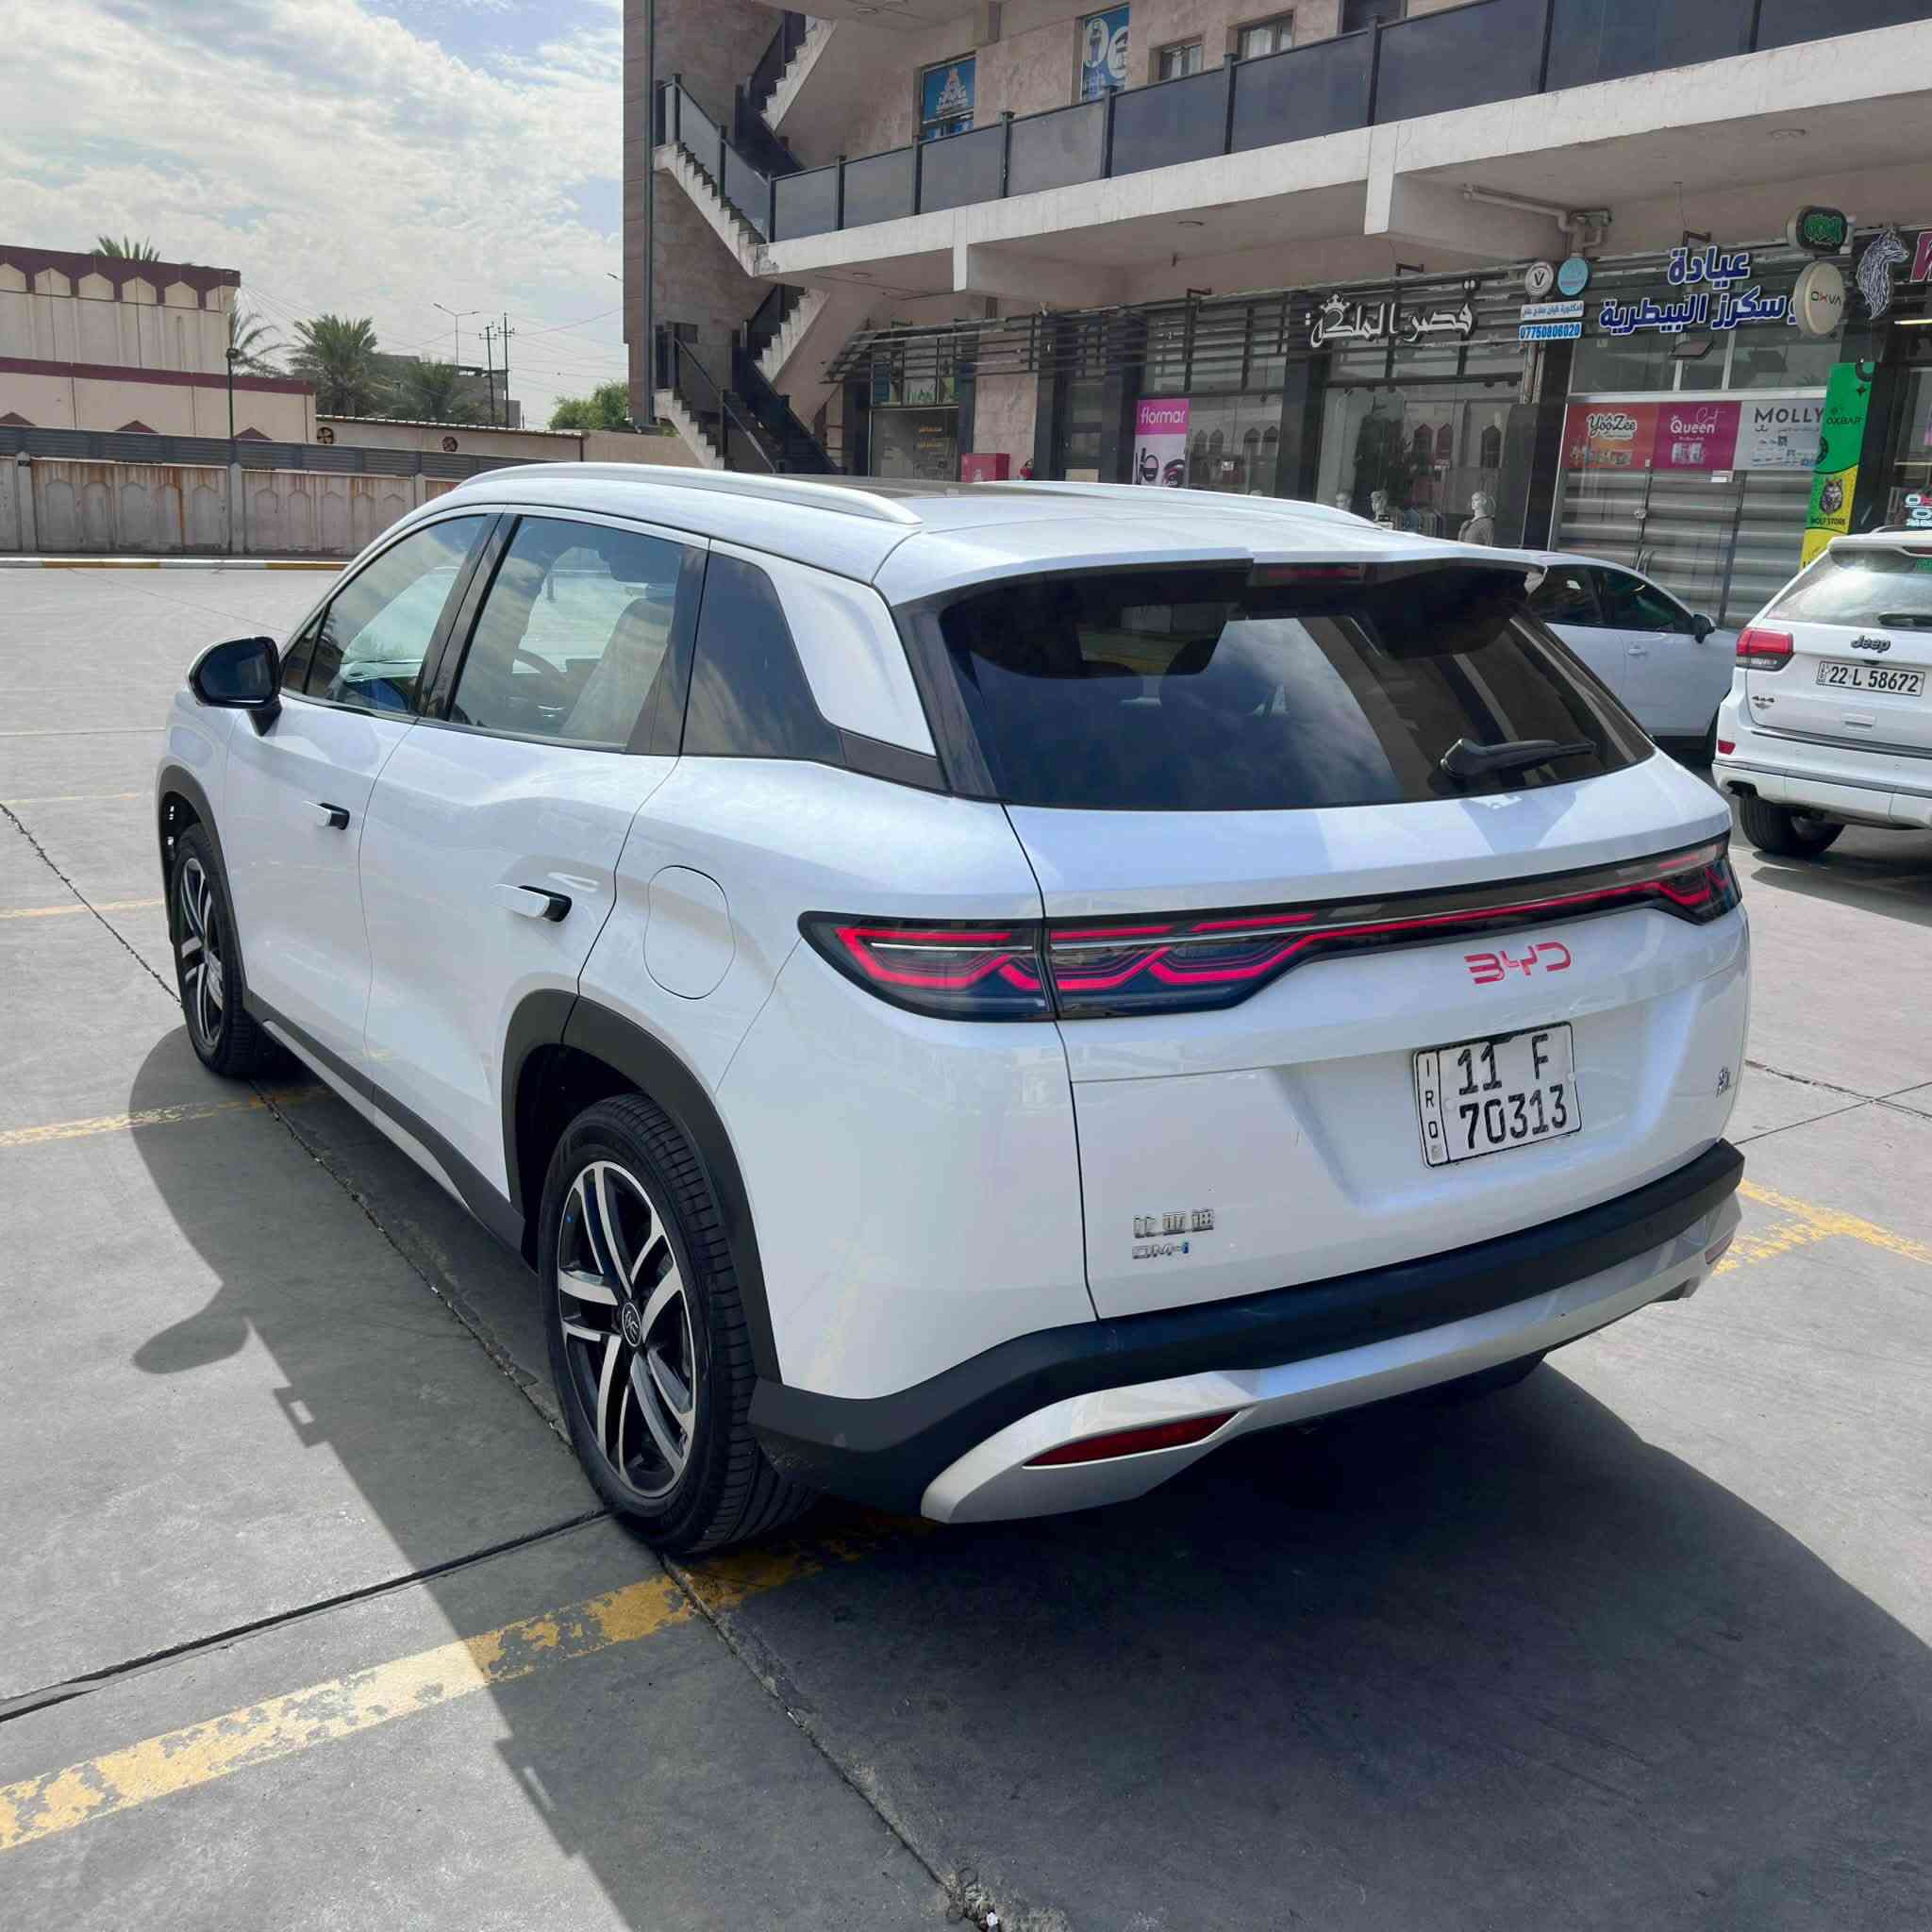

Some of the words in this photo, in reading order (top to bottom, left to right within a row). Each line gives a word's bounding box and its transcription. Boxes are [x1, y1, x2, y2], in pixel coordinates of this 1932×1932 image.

[1668, 246, 1751, 290] عيادة
[1599, 293, 1708, 336] البيطرية
[1141, 407, 1186, 424] flormar
[1670, 418, 1715, 434] Queen
[1755, 407, 1824, 424] MOLLY
[1851, 635, 1890, 653] Jeep
[1828, 666, 1848, 685] 22
[1853, 669, 1862, 686] L
[1868, 671, 1920, 693] 58672
[1464, 941, 1571, 984] BYD
[1457, 1044, 1503, 1096] 11
[1531, 1033, 1549, 1080] F
[1458, 1084, 1568, 1149] 70313
